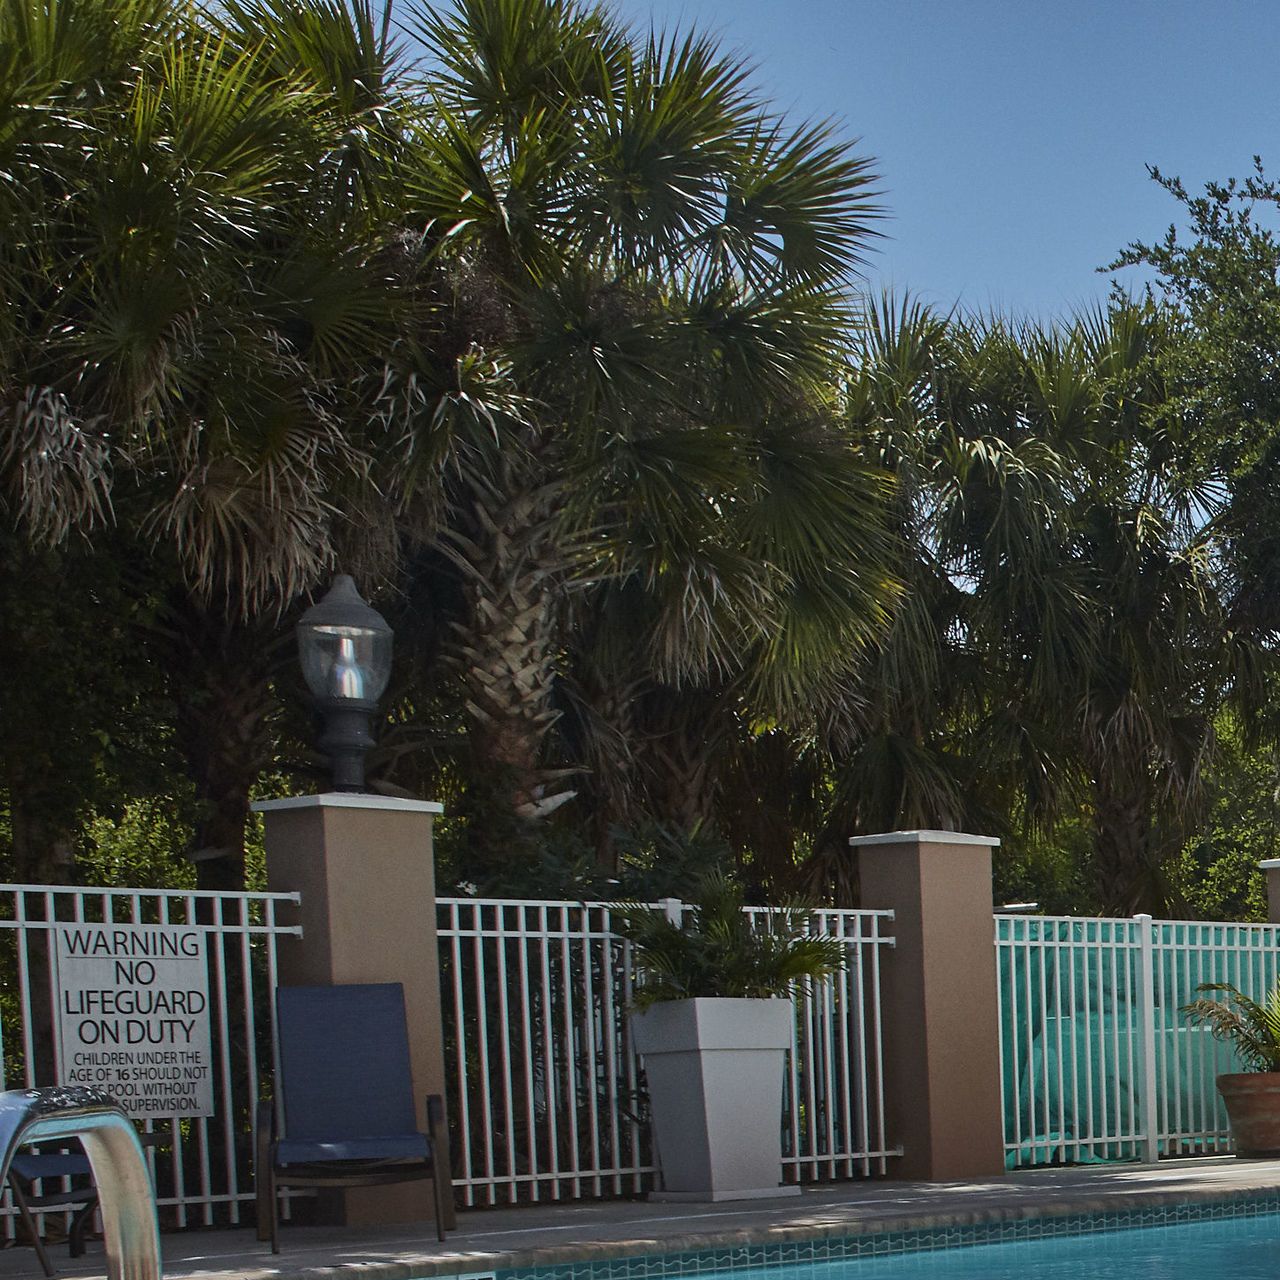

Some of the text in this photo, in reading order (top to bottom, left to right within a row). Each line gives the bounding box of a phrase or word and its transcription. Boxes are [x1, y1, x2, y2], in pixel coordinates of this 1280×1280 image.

[64, 930, 199, 956] WARNING
[115, 961, 155, 985] NO
[65, 991, 206, 1015] LIFEGUARD
[79, 1020, 196, 1044] ON DUTY
[74, 1051, 201, 1065] CHILDREN UNDER THE
[69, 1066, 208, 1082] AGE OF 16 SHOULD NOT
[108, 1083, 141, 1096] POOL
[143, 1083, 197, 1095] WITHOUT
[122, 1098, 200, 1111] SUPERVISION.
